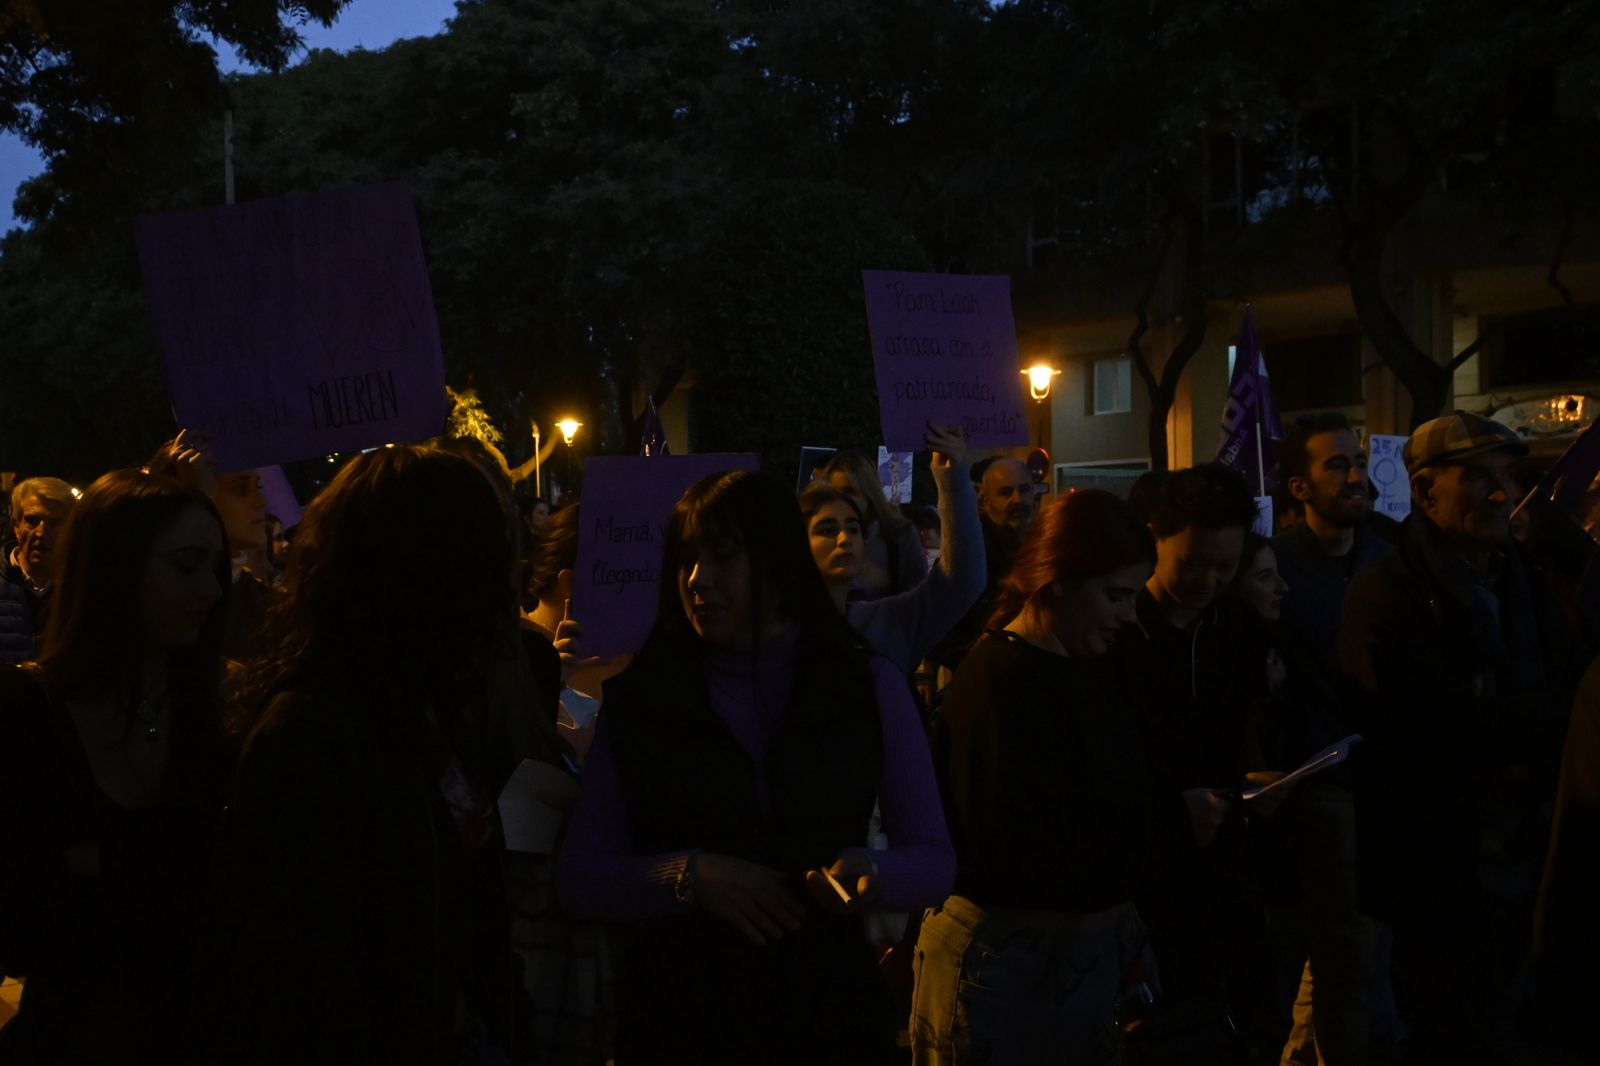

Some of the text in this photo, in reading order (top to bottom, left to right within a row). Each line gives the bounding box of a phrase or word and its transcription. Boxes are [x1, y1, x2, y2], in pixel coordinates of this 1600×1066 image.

[884, 335, 944, 357] arrasa
[948, 337, 973, 358] con
[306, 369, 400, 431] MUEREN
[892, 375, 996, 408] patriarcado,
[593, 515, 654, 545] Mamá,
[591, 558, 661, 596] llegando
